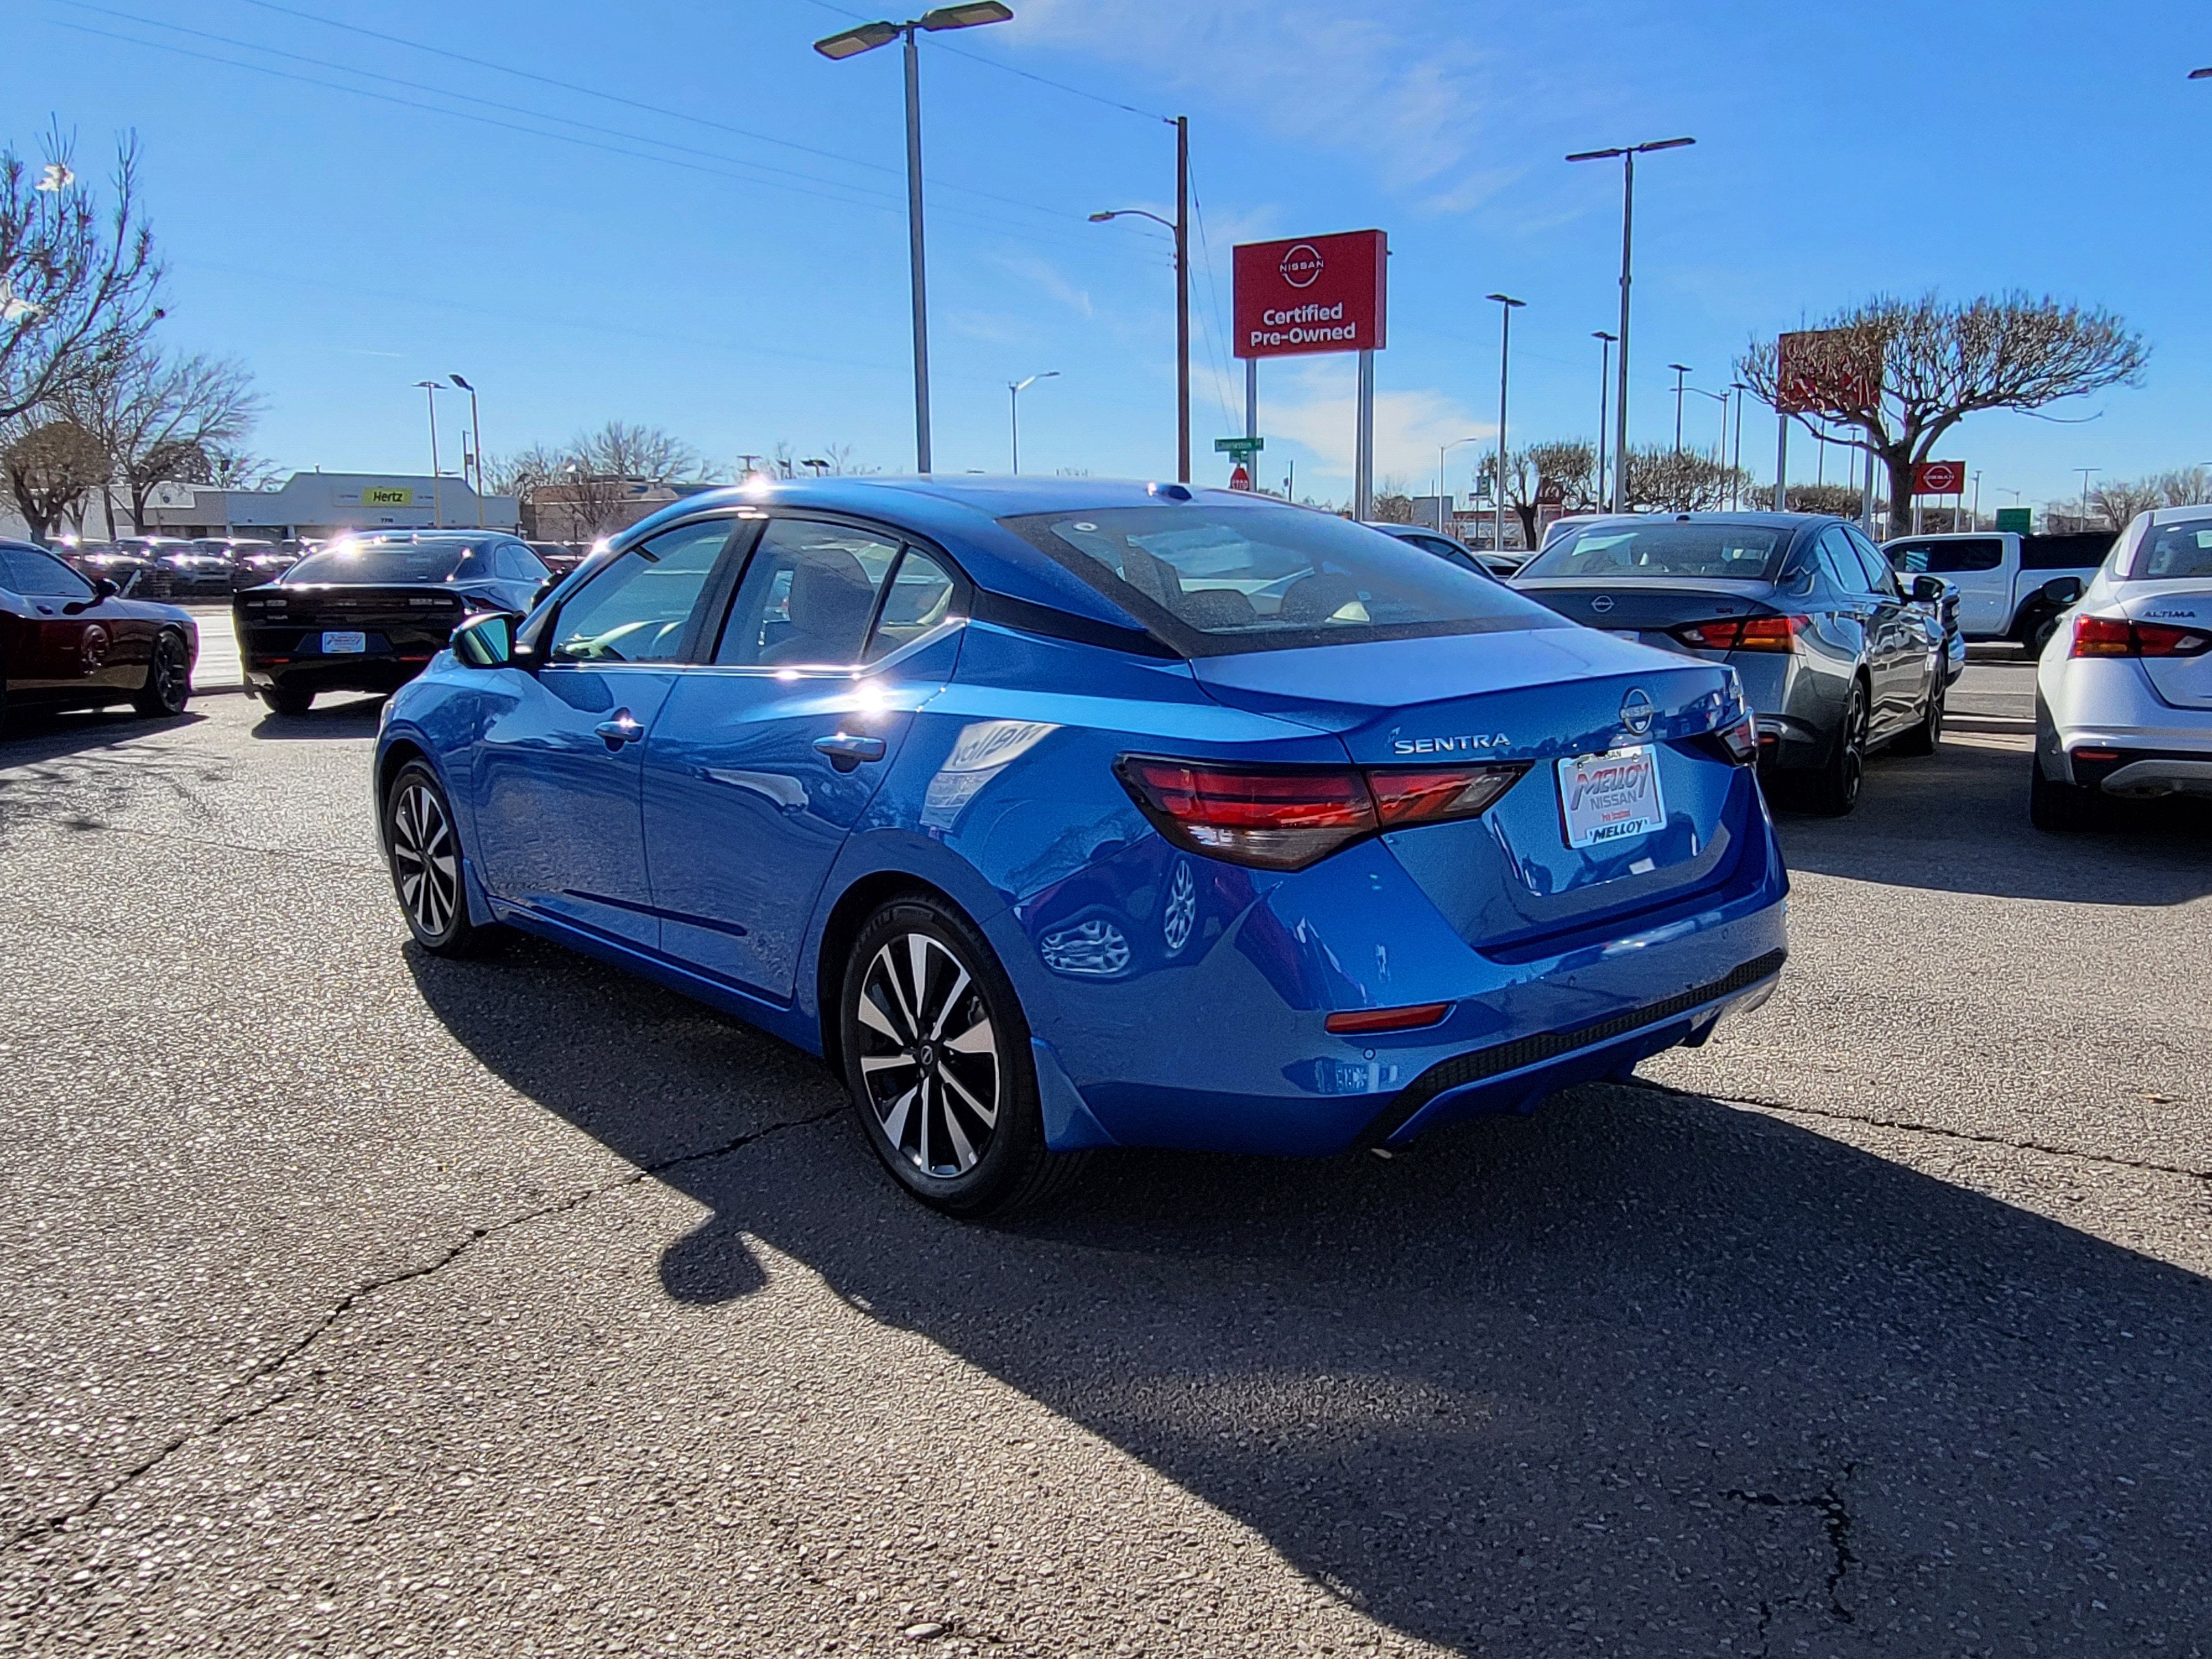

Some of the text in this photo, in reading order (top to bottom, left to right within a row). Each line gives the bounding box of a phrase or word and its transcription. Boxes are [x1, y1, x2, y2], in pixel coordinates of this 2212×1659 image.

[1280, 260, 1324, 273] NISSAN
[1263, 301, 1343, 326] Certified
[1250, 322, 1356, 347] Pre-Owned
[373, 492, 403, 502] Hertz
[1394, 733, 1511, 754] SENTRA
[1570, 763, 1648, 811] MELLOY
[1590, 790, 1637, 811] NISSAN
